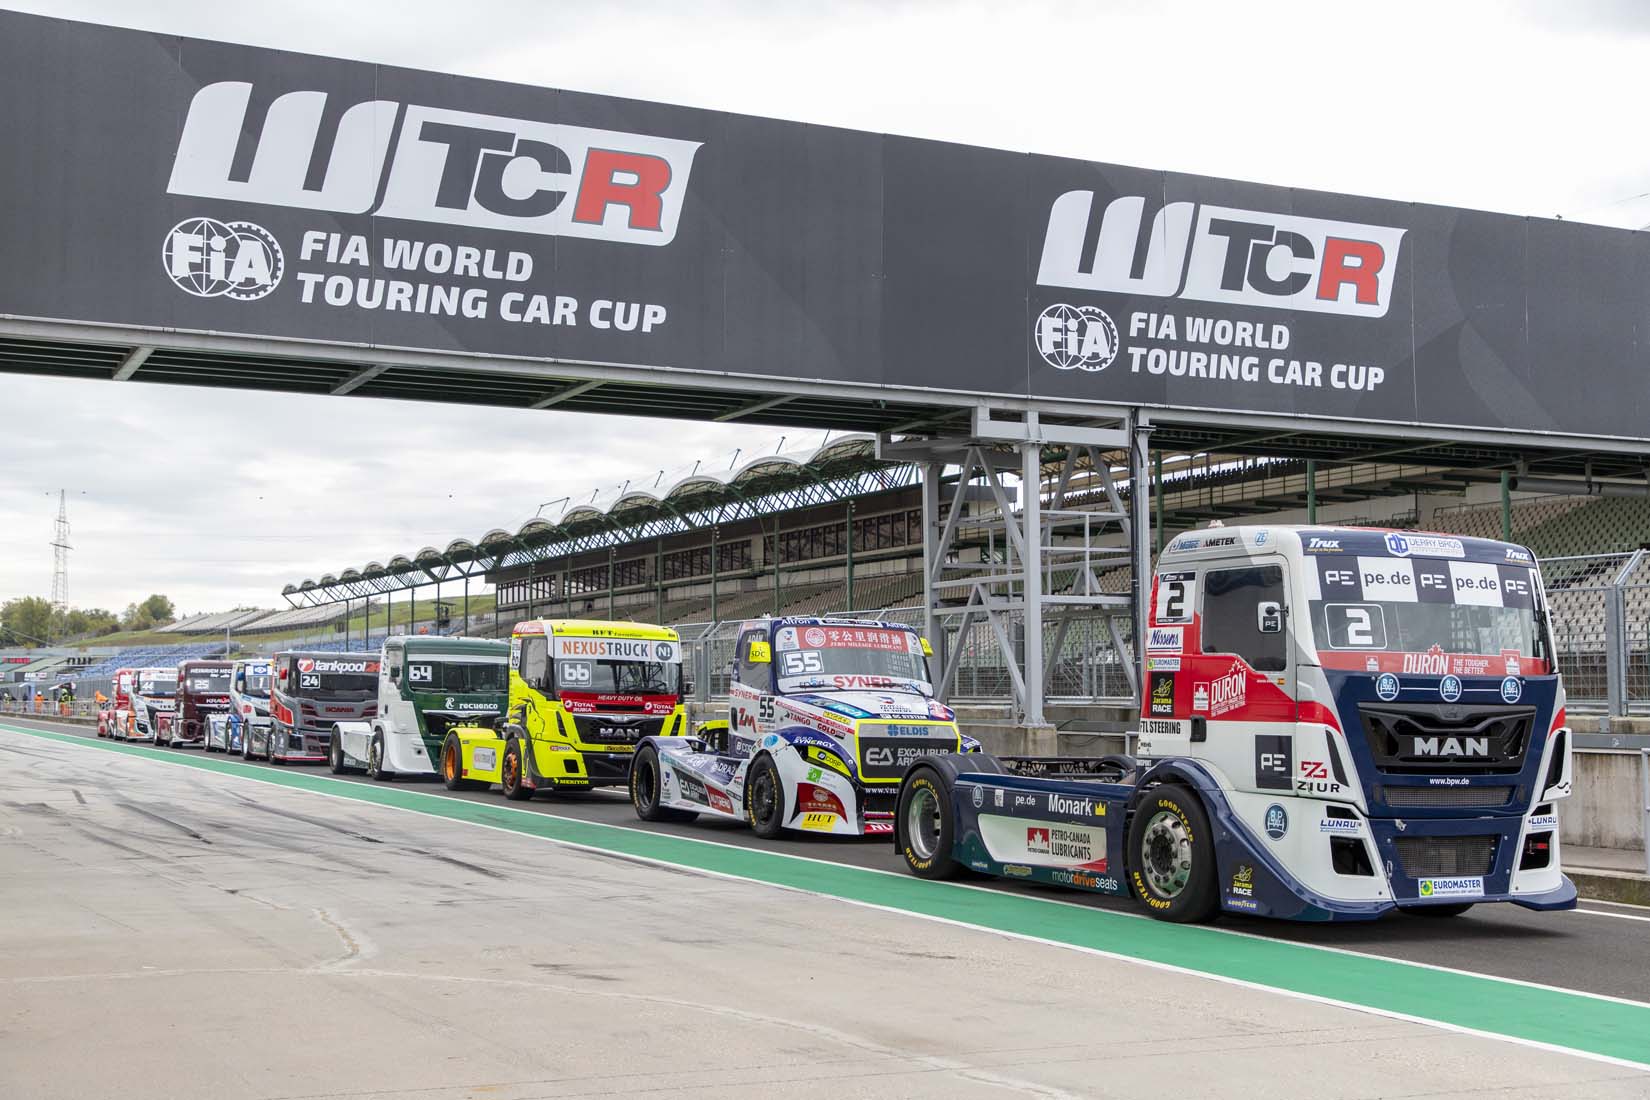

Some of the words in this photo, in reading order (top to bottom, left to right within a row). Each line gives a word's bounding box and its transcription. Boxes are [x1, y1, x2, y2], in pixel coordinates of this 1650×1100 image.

[167, 81, 704, 247] WTCR
[301, 230, 370, 267] FIA
[383, 237, 534, 283] WORLD
[1037, 190, 1408, 318] WTCR
[297, 272, 488, 320] TOURING
[500, 291, 578, 327] CAR
[589, 300, 667, 334] CUP
[1129, 311, 1178, 339] FIA
[1184, 316, 1290, 350] WORLD
[1128, 346, 1260, 383] TOURING
[1268, 357, 1323, 388] CAR
[1330, 363, 1385, 392] CUP
[1309, 538, 1340, 548] Trux
[1409, 538, 1436, 547] DERRY
[1505, 549, 1529, 559] Trux
[1325, 571, 1354, 585] PE
[1364, 572, 1411, 586] pe.de
[1420, 574, 1447, 588] PE
[1455, 576, 1497, 591] pe.de
[1505, 580, 1529, 595] PE
[1166, 583, 1185, 617] 2
[1346, 608, 1373, 645] 2
[1150, 630, 1179, 646] Nissens
[562, 641, 649, 658] NEXUSTRUCK
[786, 652, 821, 675] 55
[1154, 658, 1180, 666] EUROMASTER
[1403, 654, 1449, 674] DURON
[1453, 659, 1463, 667] THE
[1453, 666, 1462, 674] THE
[302, 675, 319, 687] 24
[1212, 670, 1246, 705] DURON
[459, 702, 498, 710] recuenco
[760, 697, 775, 718] 55
[790, 713, 811, 726] TANGO
[600, 727, 639, 738] MAN
[817, 723, 836, 735] GOLD
[900, 726, 929, 736] ELDIS
[1150, 720, 1181, 734] STEERING
[792, 739, 836, 749] SYNERGY
[1414, 737, 1488, 756] MAN
[1260, 753, 1286, 771] PE
[1297, 781, 1340, 793] ZIUR
[1430, 777, 1469, 787] www.bpw.de
[1015, 795, 1036, 806] pe.de
[1048, 793, 1093, 817] Monark
[808, 813, 833, 823] HUT
[1158, 799, 1195, 842] GOODYEAR
[1320, 819, 1358, 829] LUNAU
[1531, 816, 1557, 825] LUNAU
[1051, 829, 1091, 844] PETRO-CANADA
[1051, 842, 1091, 860] LUBRICANTS
[1052, 870, 1118, 891] motordriveseats
[1433, 879, 1481, 890] EUROMASTER
[1133, 871, 1171, 909] GOODYEAR
[1233, 887, 1252, 896] RACE
